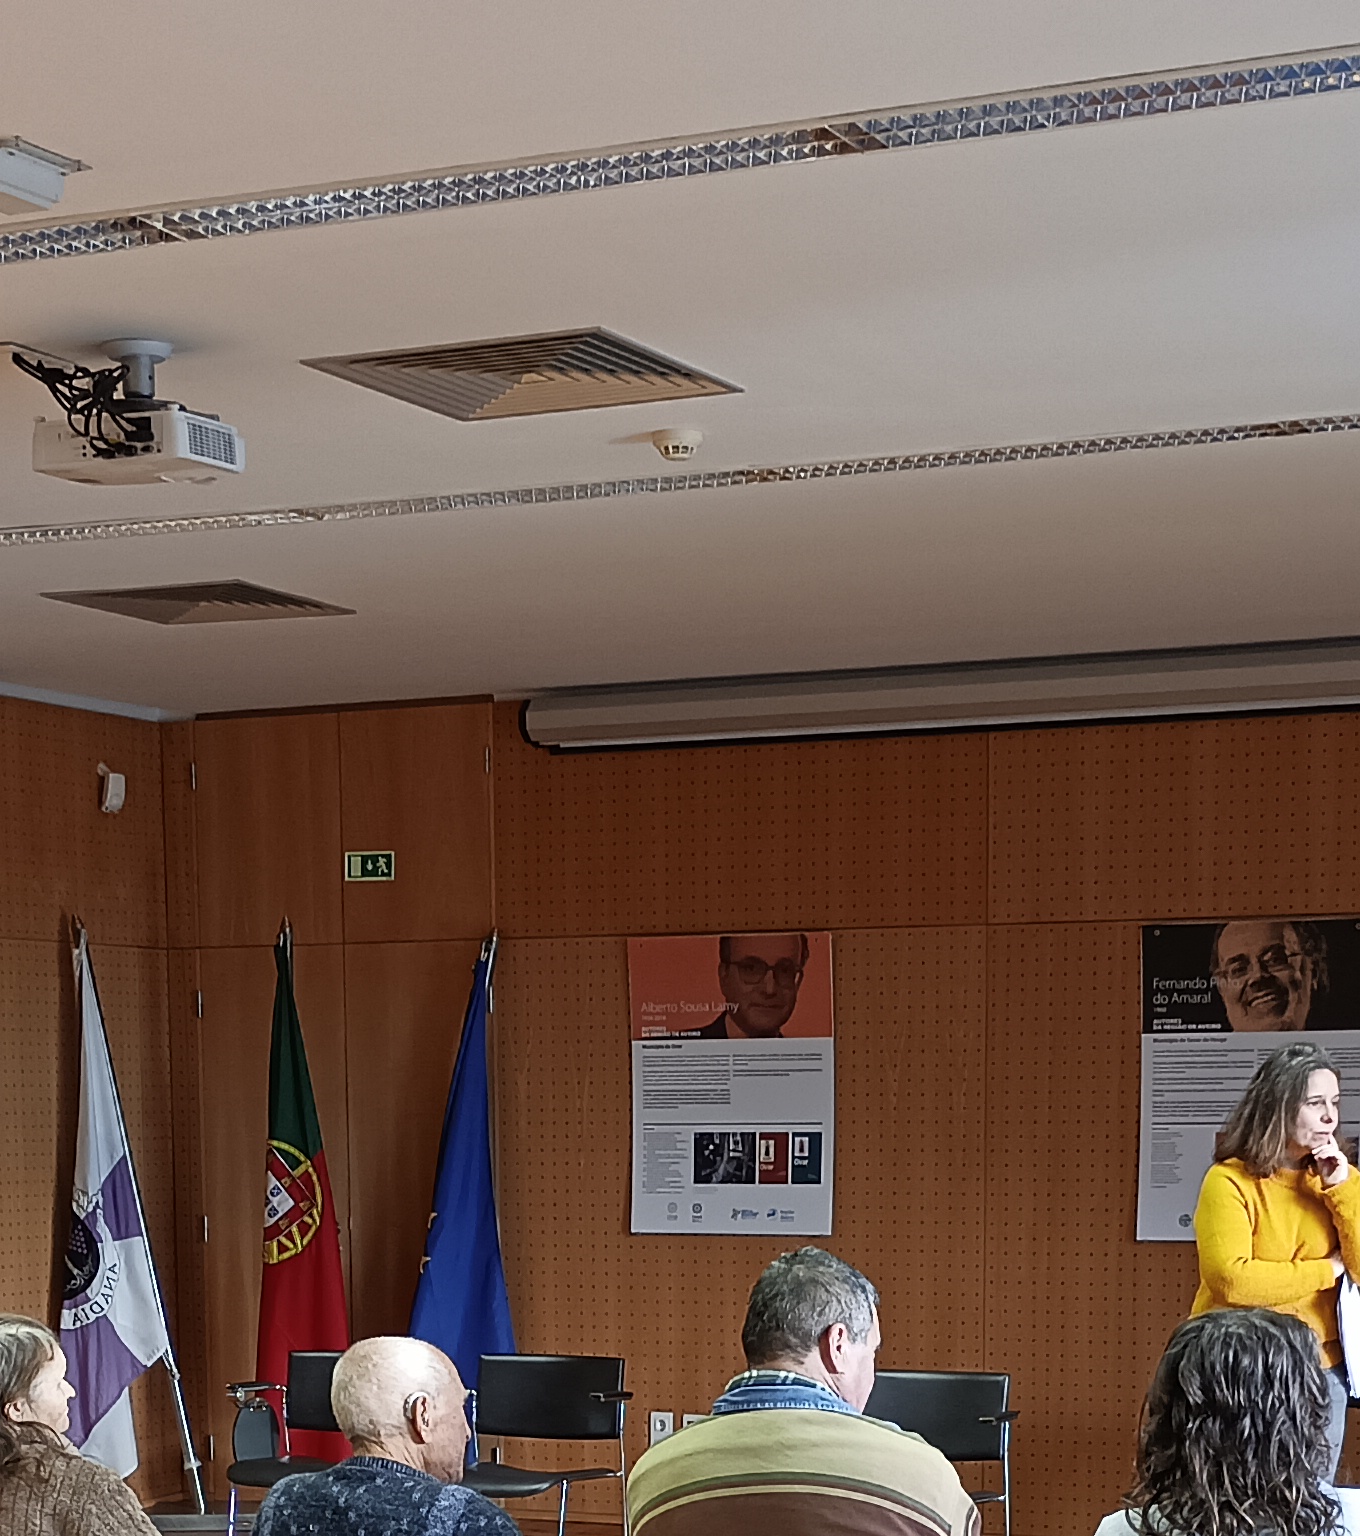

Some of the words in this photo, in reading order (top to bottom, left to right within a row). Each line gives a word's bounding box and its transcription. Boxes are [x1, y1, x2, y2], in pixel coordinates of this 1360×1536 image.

[1153, 976, 1208, 990] Fernando
[1152, 992, 1169, 1004] do
[1170, 990, 1212, 1004] Amaral
[640, 1001, 678, 1013] Alberto
[679, 1001, 709, 1013] Sousa
[711, 1001, 740, 1014] Lamy
